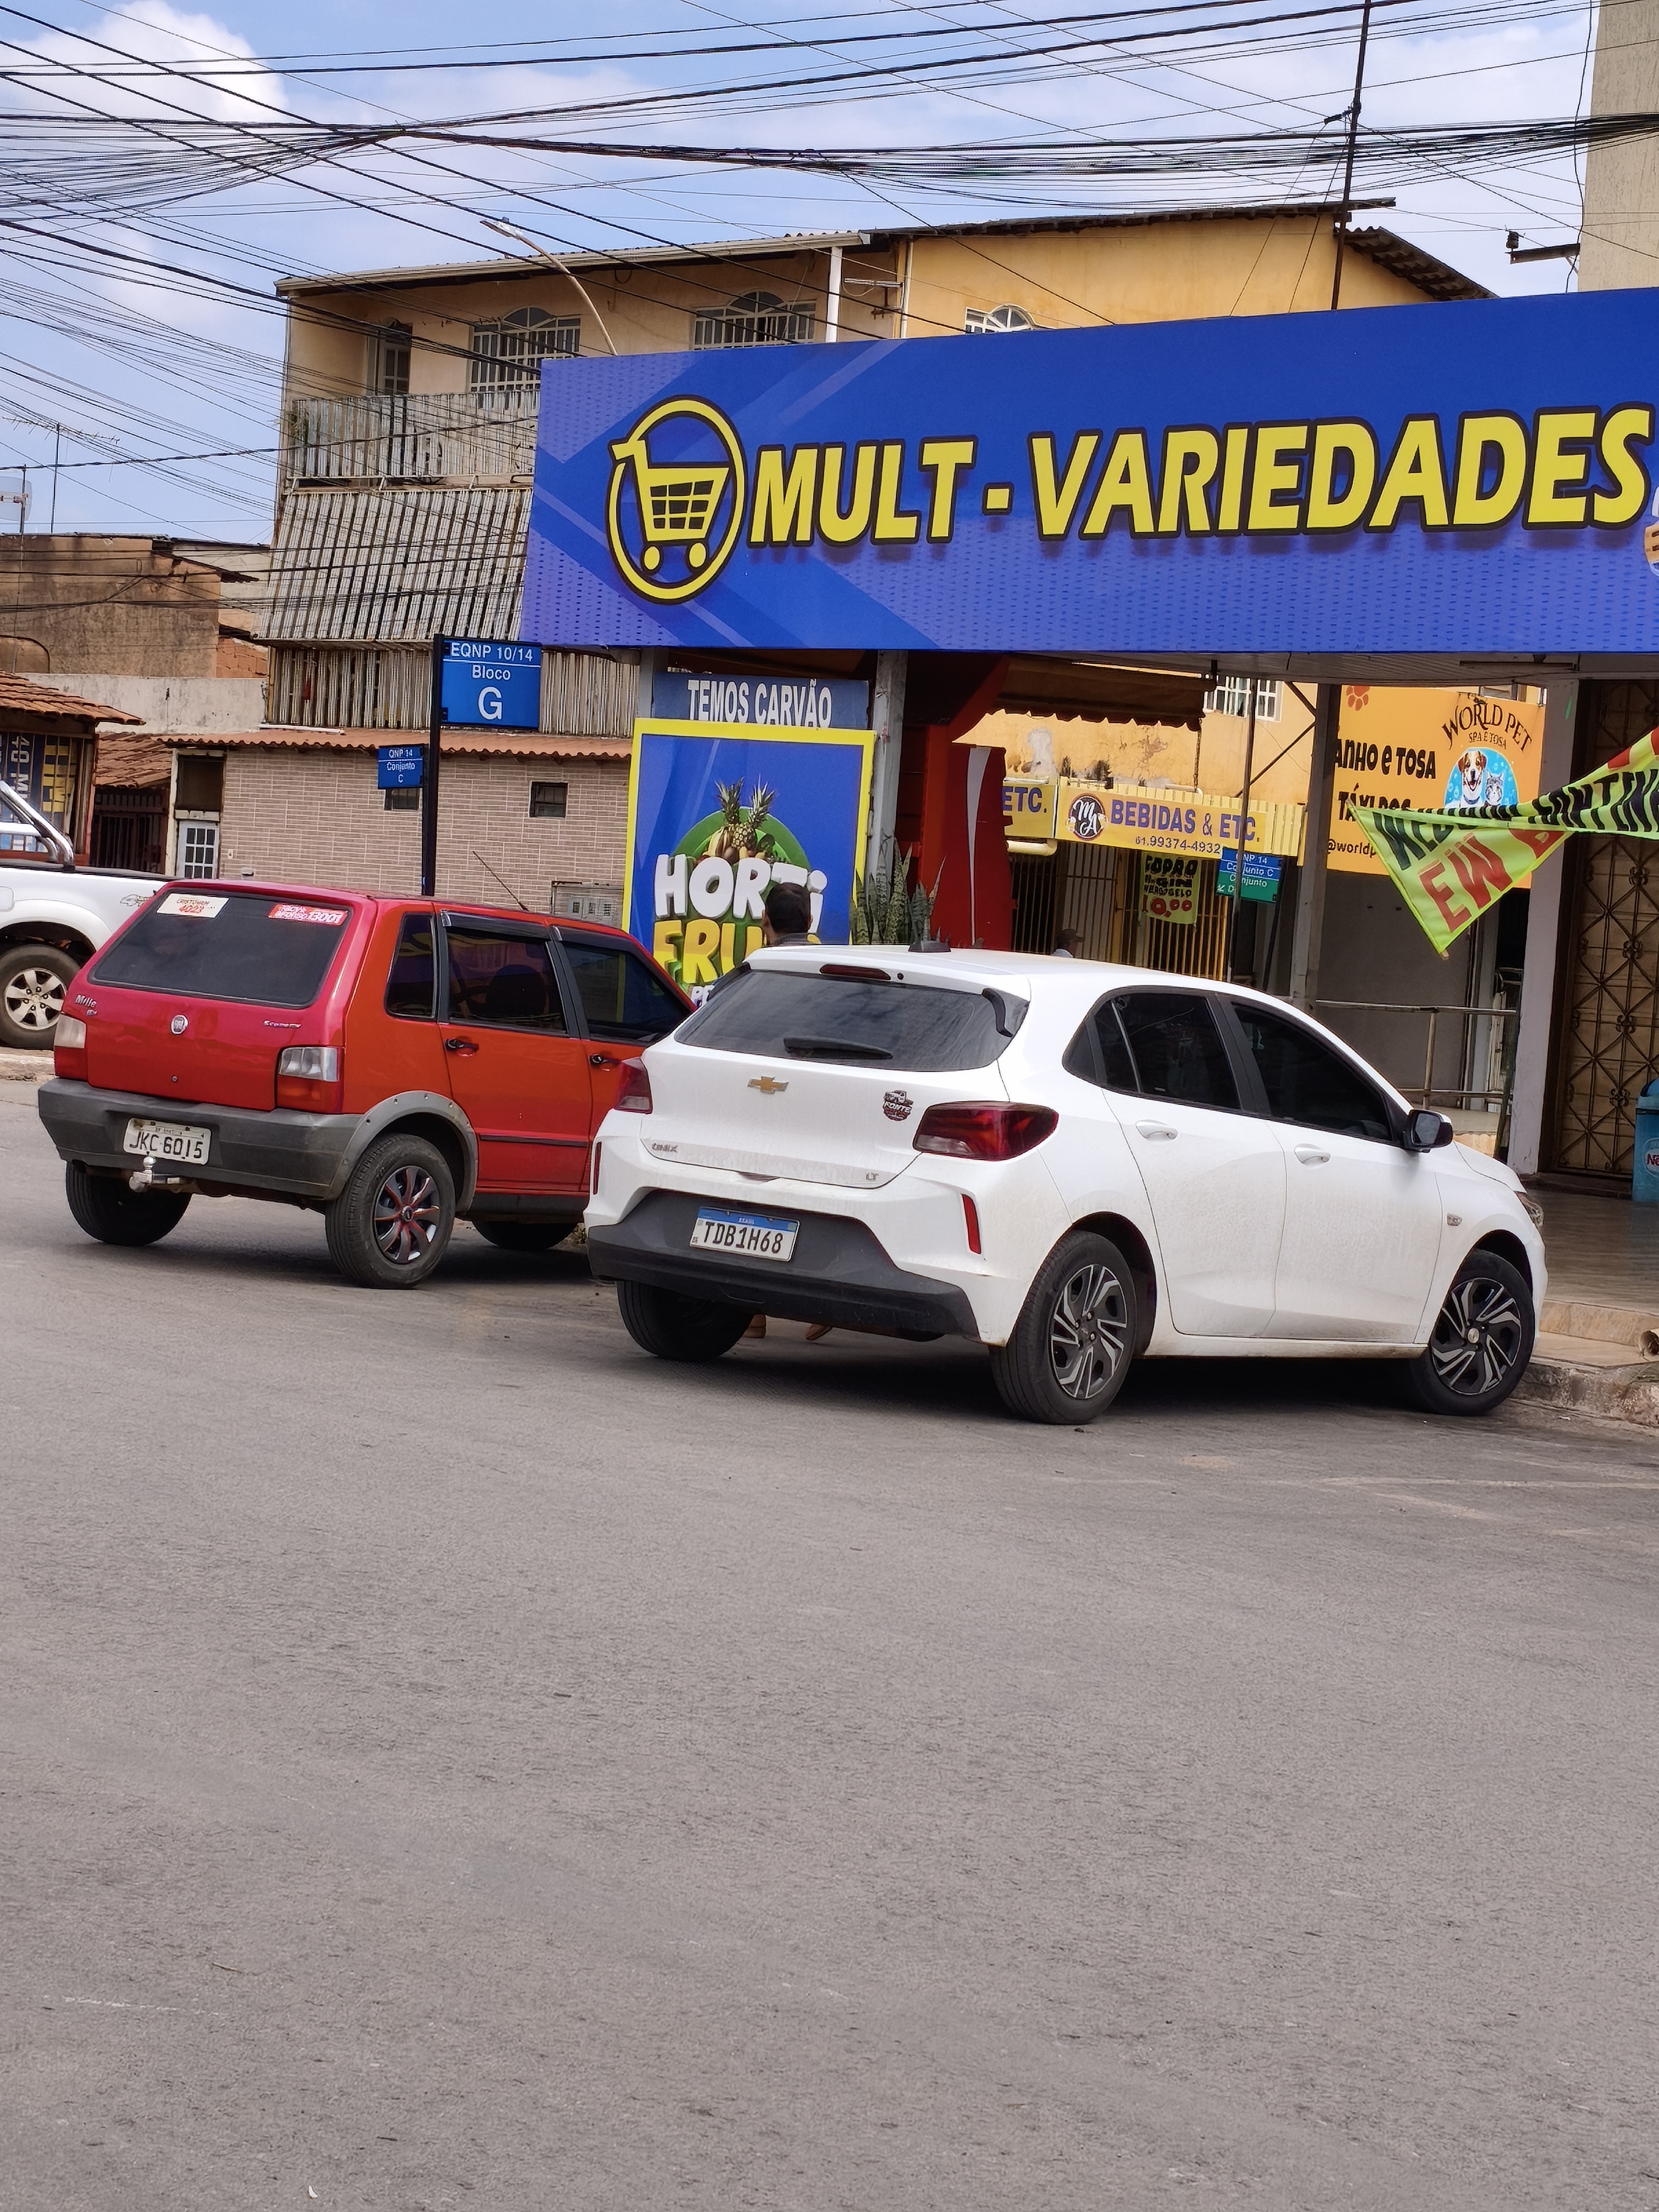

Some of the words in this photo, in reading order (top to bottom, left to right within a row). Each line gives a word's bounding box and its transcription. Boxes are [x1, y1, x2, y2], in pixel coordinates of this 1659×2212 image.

[748, 439, 976, 545] MULT
[1029, 406, 1653, 538] VARIEDADES
[450, 642, 491, 658] EQNP
[497, 647, 532, 662] 10/14
[472, 664, 511, 680] Bloco
[478, 686, 503, 720] G
[687, 679, 749, 723] TEMOS
[755, 679, 832, 728] CARVÃO
[1441, 703, 1503, 750] WORLD
[1505, 712, 1533, 752] PET
[1468, 731, 1482, 743] SPA
[1489, 732, 1507, 750] TOSA
[389, 749, 403, 758] QNP
[406, 748, 413, 757] 14
[387, 761, 415, 772] Conjunto
[1396, 747, 1436, 779] TOSA
[398, 774, 404, 783] C
[1111, 799, 1196, 834] BEBIDAS
[1202, 813, 1212, 837] &
[1236, 853, 1256, 862] NP
[1258, 855, 1267, 864] 14
[1226, 862, 1265, 875] Cojunto
[1267, 868, 1274, 876] C
[1229, 874, 1267, 887] Cnjunto
[75, 994, 97, 1008] Mille
[703, 1221, 783, 1254] TDB1H68
